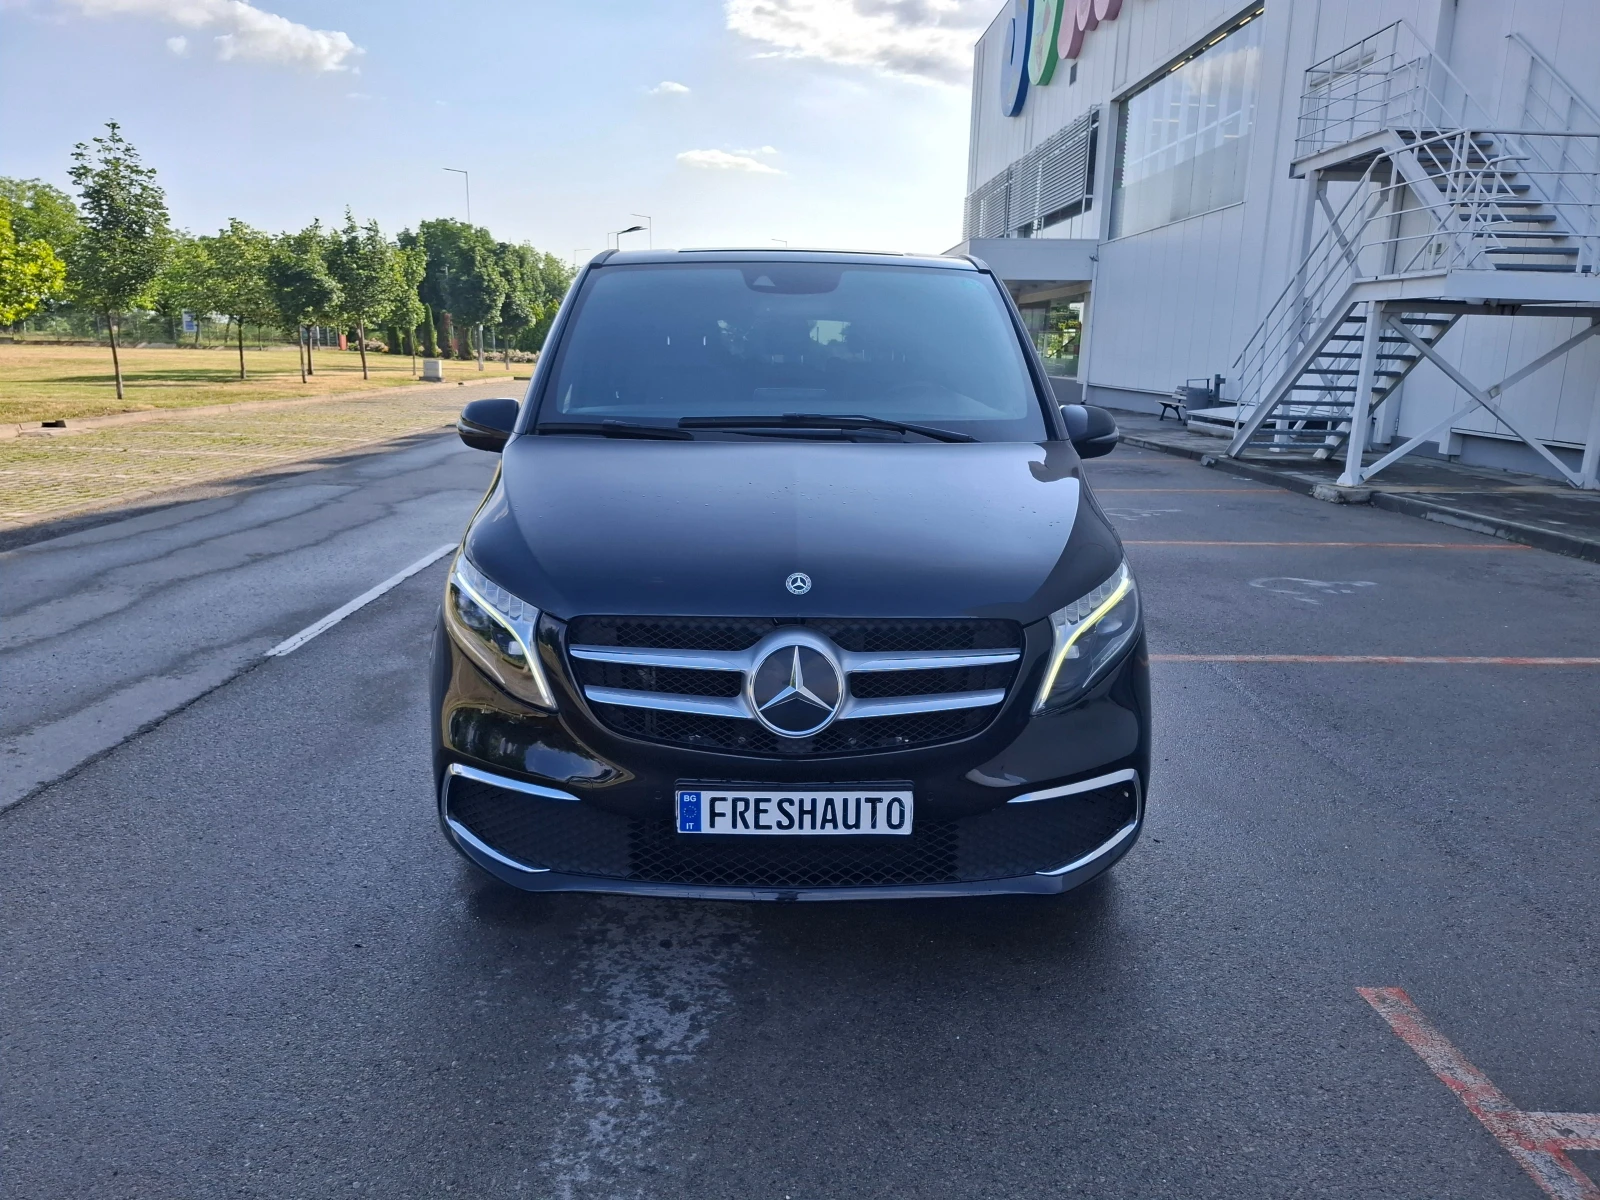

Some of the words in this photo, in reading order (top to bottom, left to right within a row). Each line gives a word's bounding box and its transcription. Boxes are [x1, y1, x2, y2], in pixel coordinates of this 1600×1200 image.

[683, 794, 697, 802] BG
[708, 796, 906, 830] FRESHAUTO
[685, 822, 694, 830] IT
